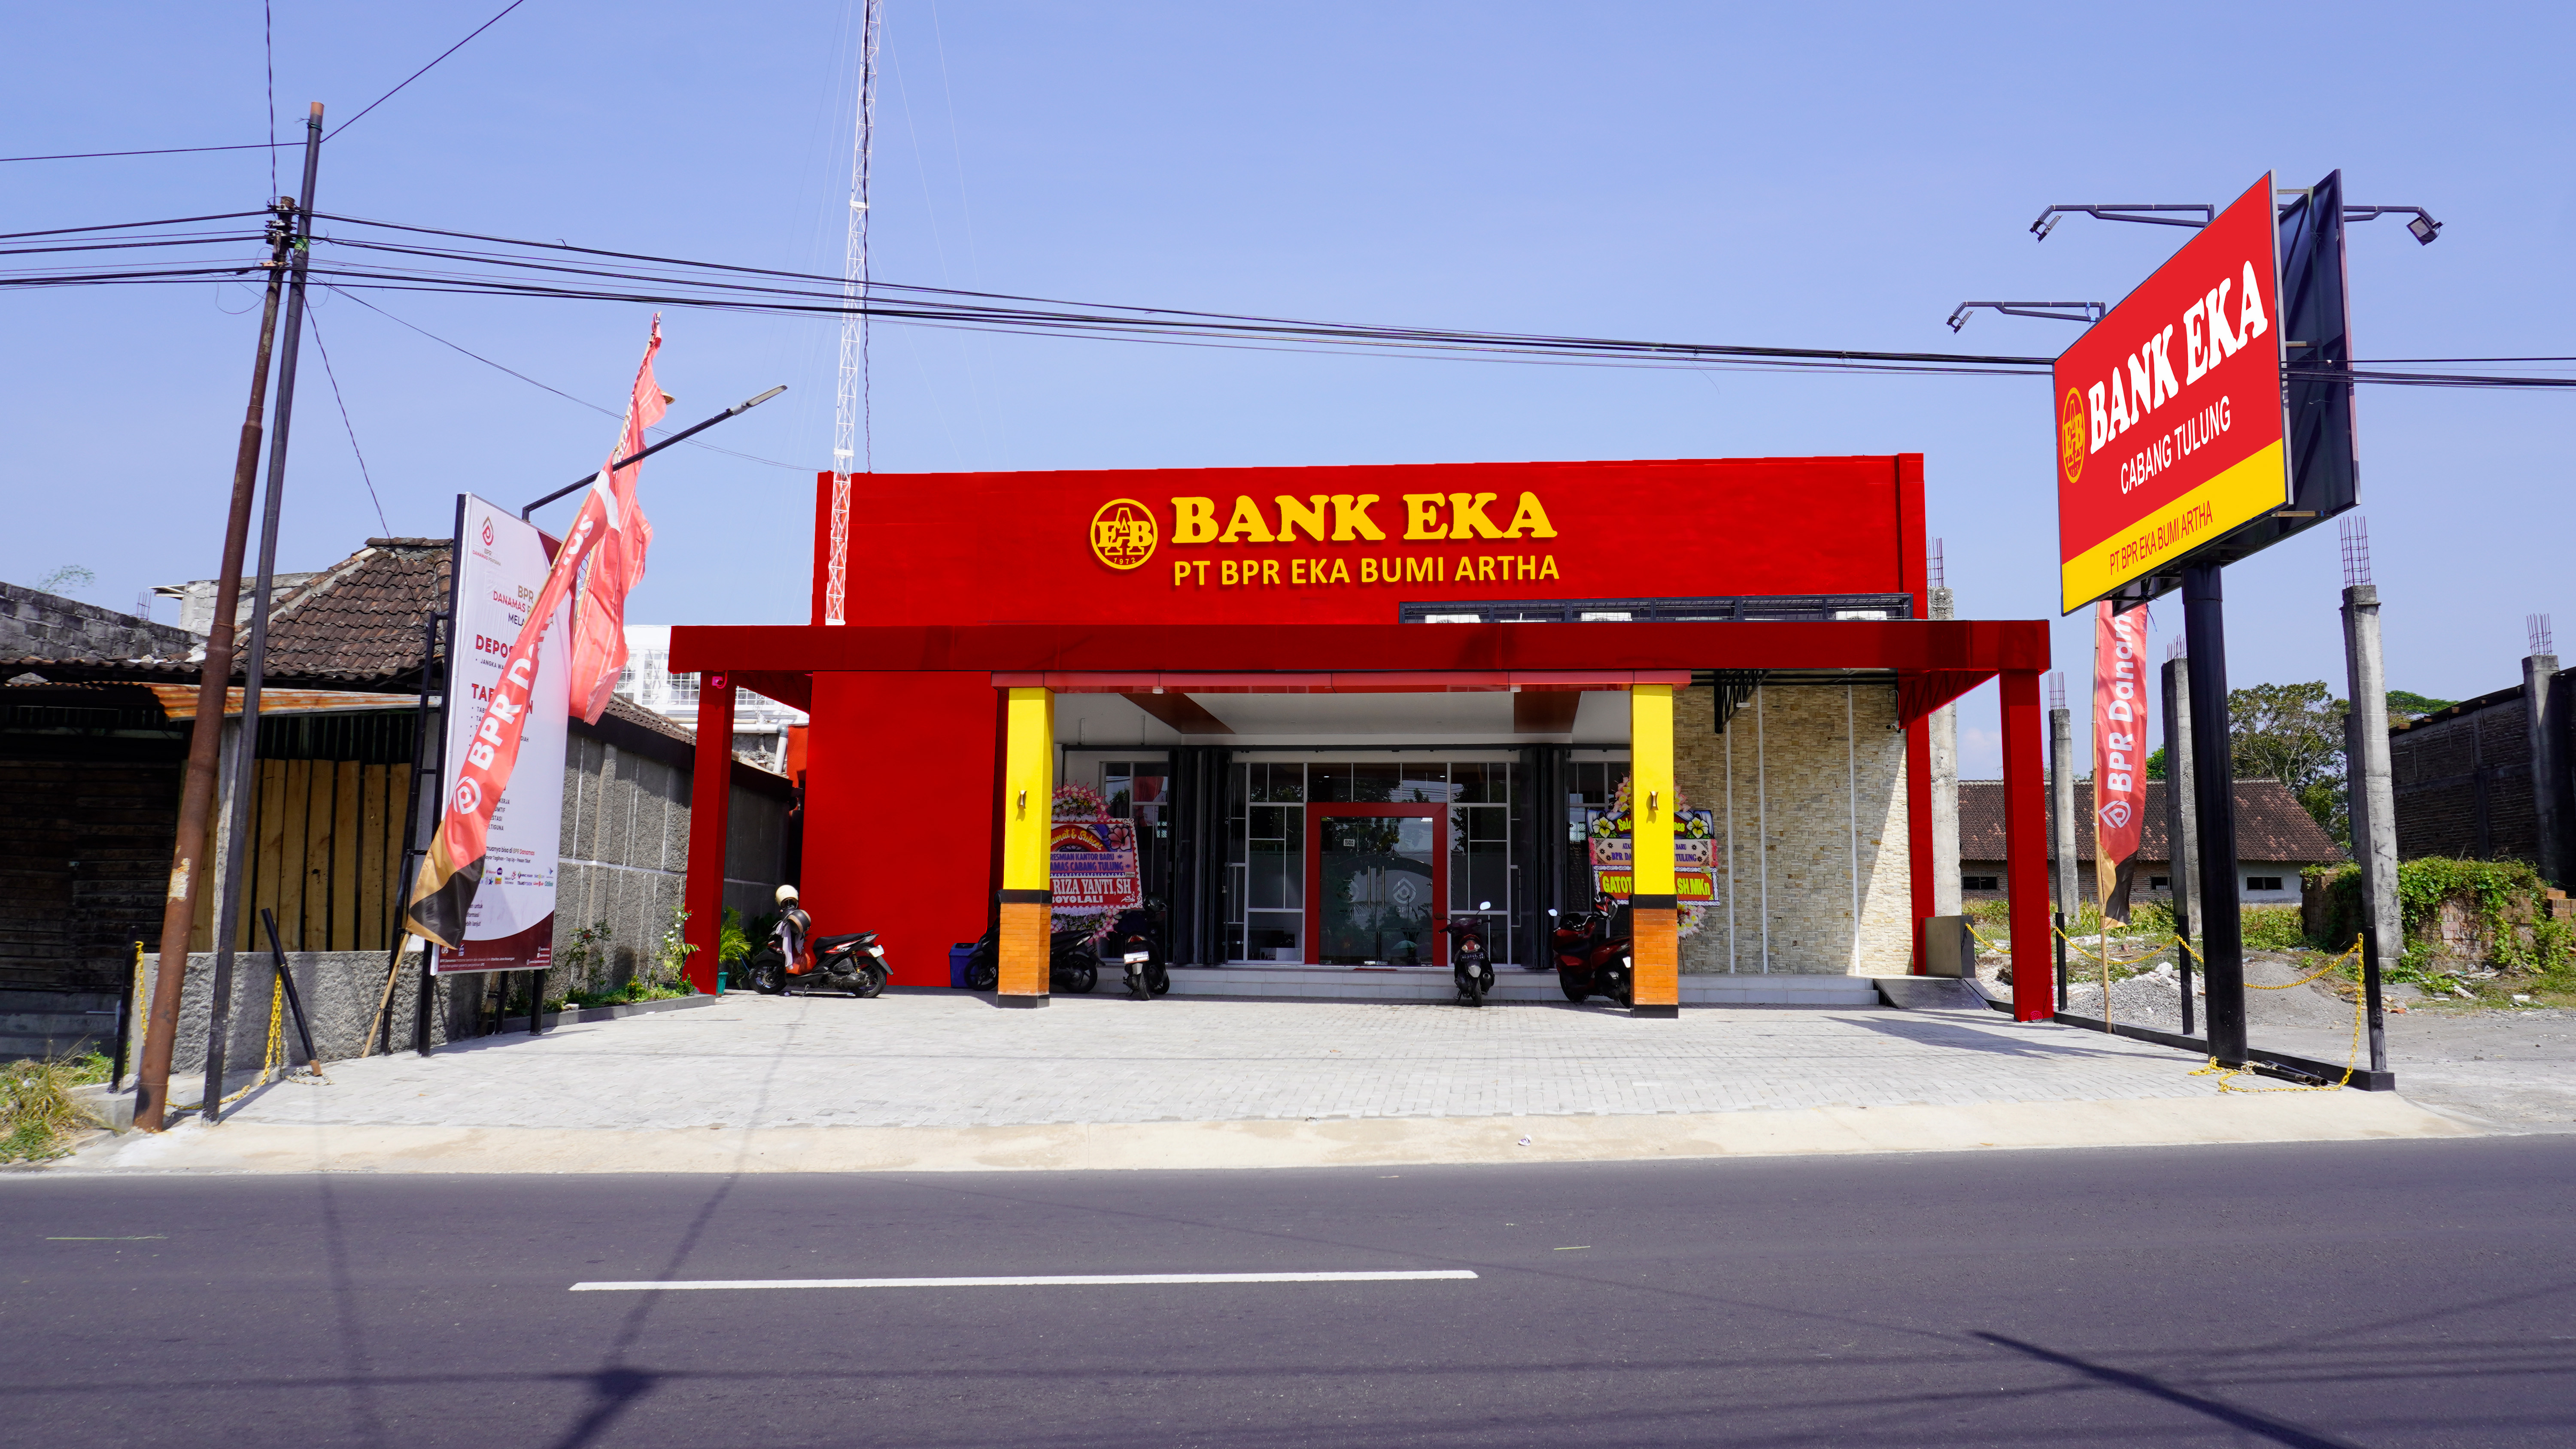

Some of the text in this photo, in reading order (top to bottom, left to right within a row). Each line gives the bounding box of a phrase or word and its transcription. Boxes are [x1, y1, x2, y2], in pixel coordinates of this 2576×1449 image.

[2089, 261, 2268, 454] BANK EKA
[2121, 396, 2230, 494] CABANG TULUNG
[2071, 465, 2079, 477] 1972
[1171, 491, 1557, 543] BANK EKA
[2110, 500, 2213, 575] PT BPR EKA BUMI ARTHA
[472, 550, 488, 560] DANAMAS
[484, 548, 492, 556] BPR
[1175, 555, 1559, 585] PT BPR EKA BUMI ARTHA
[493, 591, 526, 612] DANAMAS
[518, 585, 534, 603] BPR
[480, 659, 497, 668] JANGKA
[2107, 610, 2134, 792] BPR Danam
[468, 694, 522, 771] BPR
[1078, 830, 1103, 850] Sukses
[1050, 853, 1074, 861] RESMIAN
[1611, 852, 1623, 861] BPR
[1675, 854, 1697, 862] TULUNG
[1070, 862, 1097, 871] CABANG
[1097, 861, 1124, 871] TULUNG
[1053, 879, 1080, 895] RIZA
